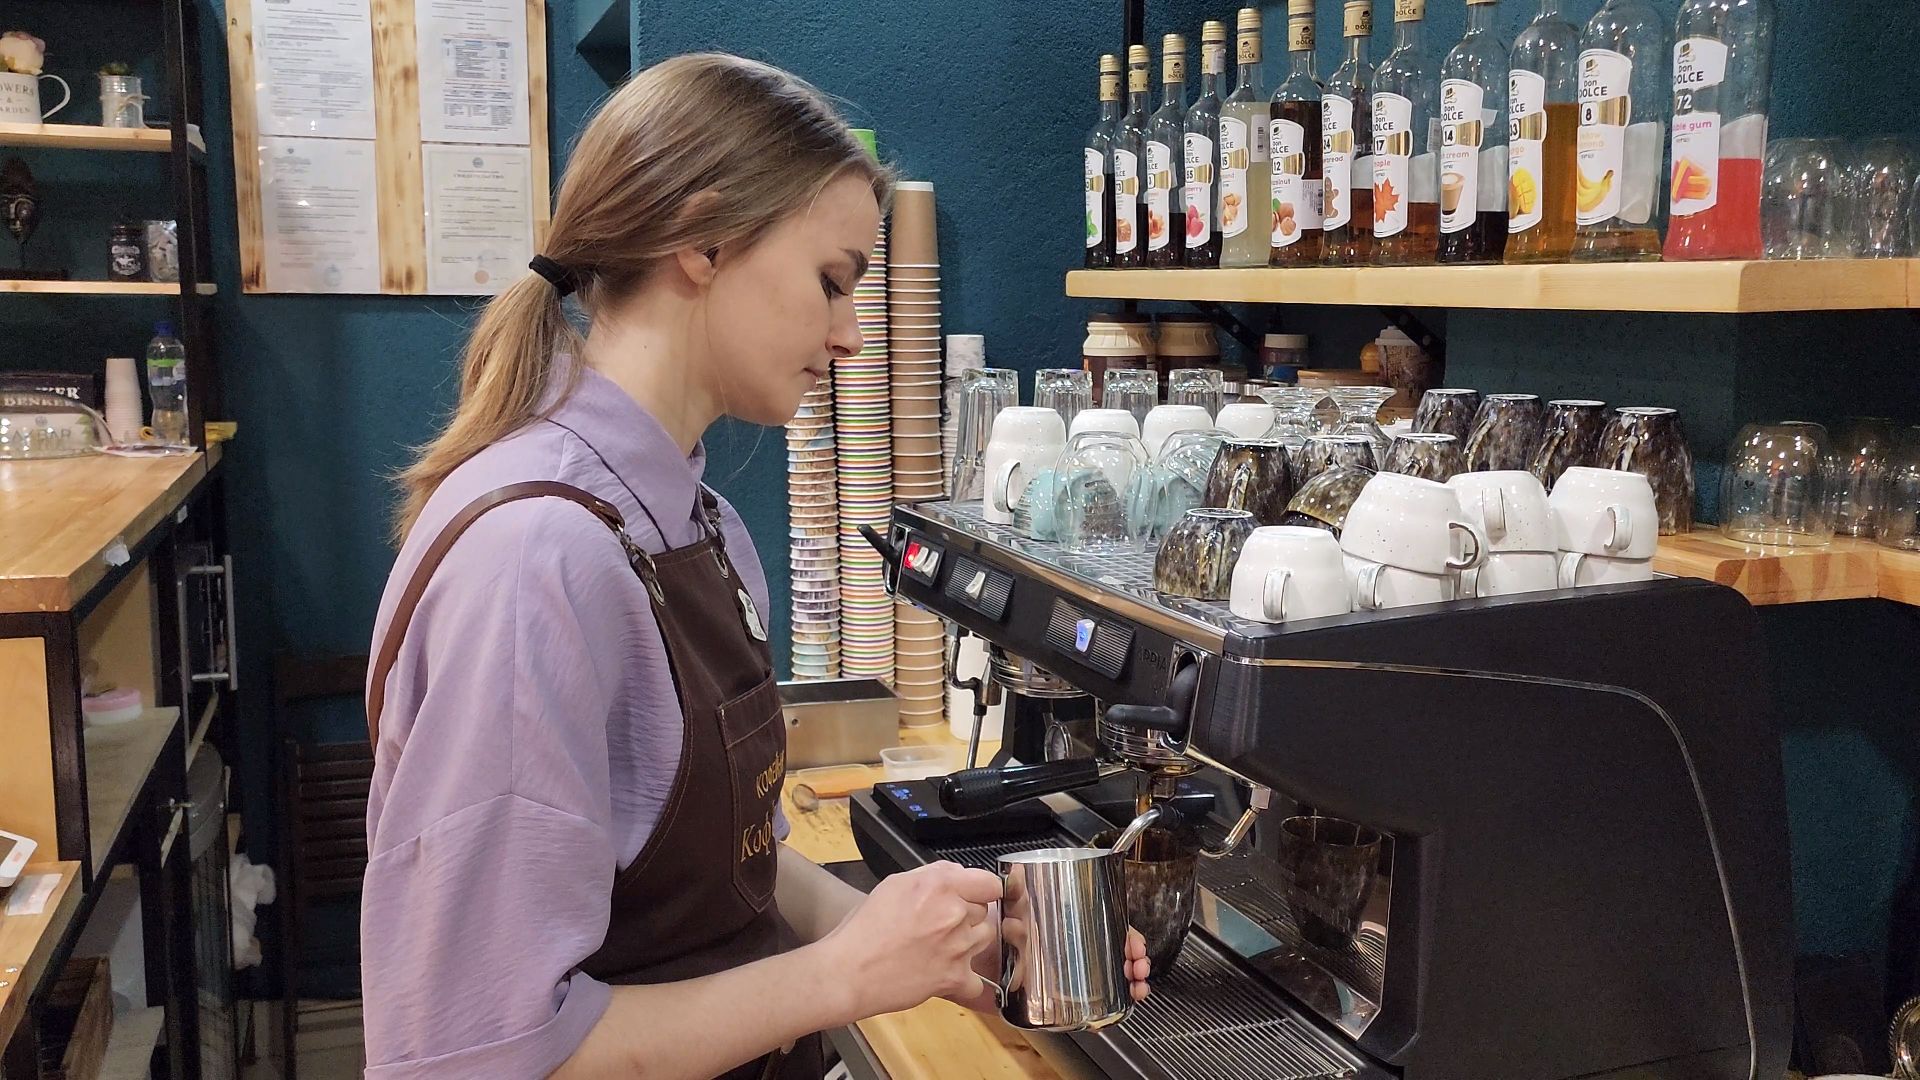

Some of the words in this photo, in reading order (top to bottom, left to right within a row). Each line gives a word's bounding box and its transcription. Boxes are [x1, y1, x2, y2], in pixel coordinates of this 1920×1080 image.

[1678, 64, 1693, 73] Don
[1583, 80, 1598, 88] Don
[1676, 94, 1693, 111] 72
[1585, 108, 1593, 122] 8
[1689, 120, 1713, 132] gum
[1444, 129, 1454, 142] 14
[1375, 140, 1385, 151] 17
[1273, 161, 1281, 171] 12
